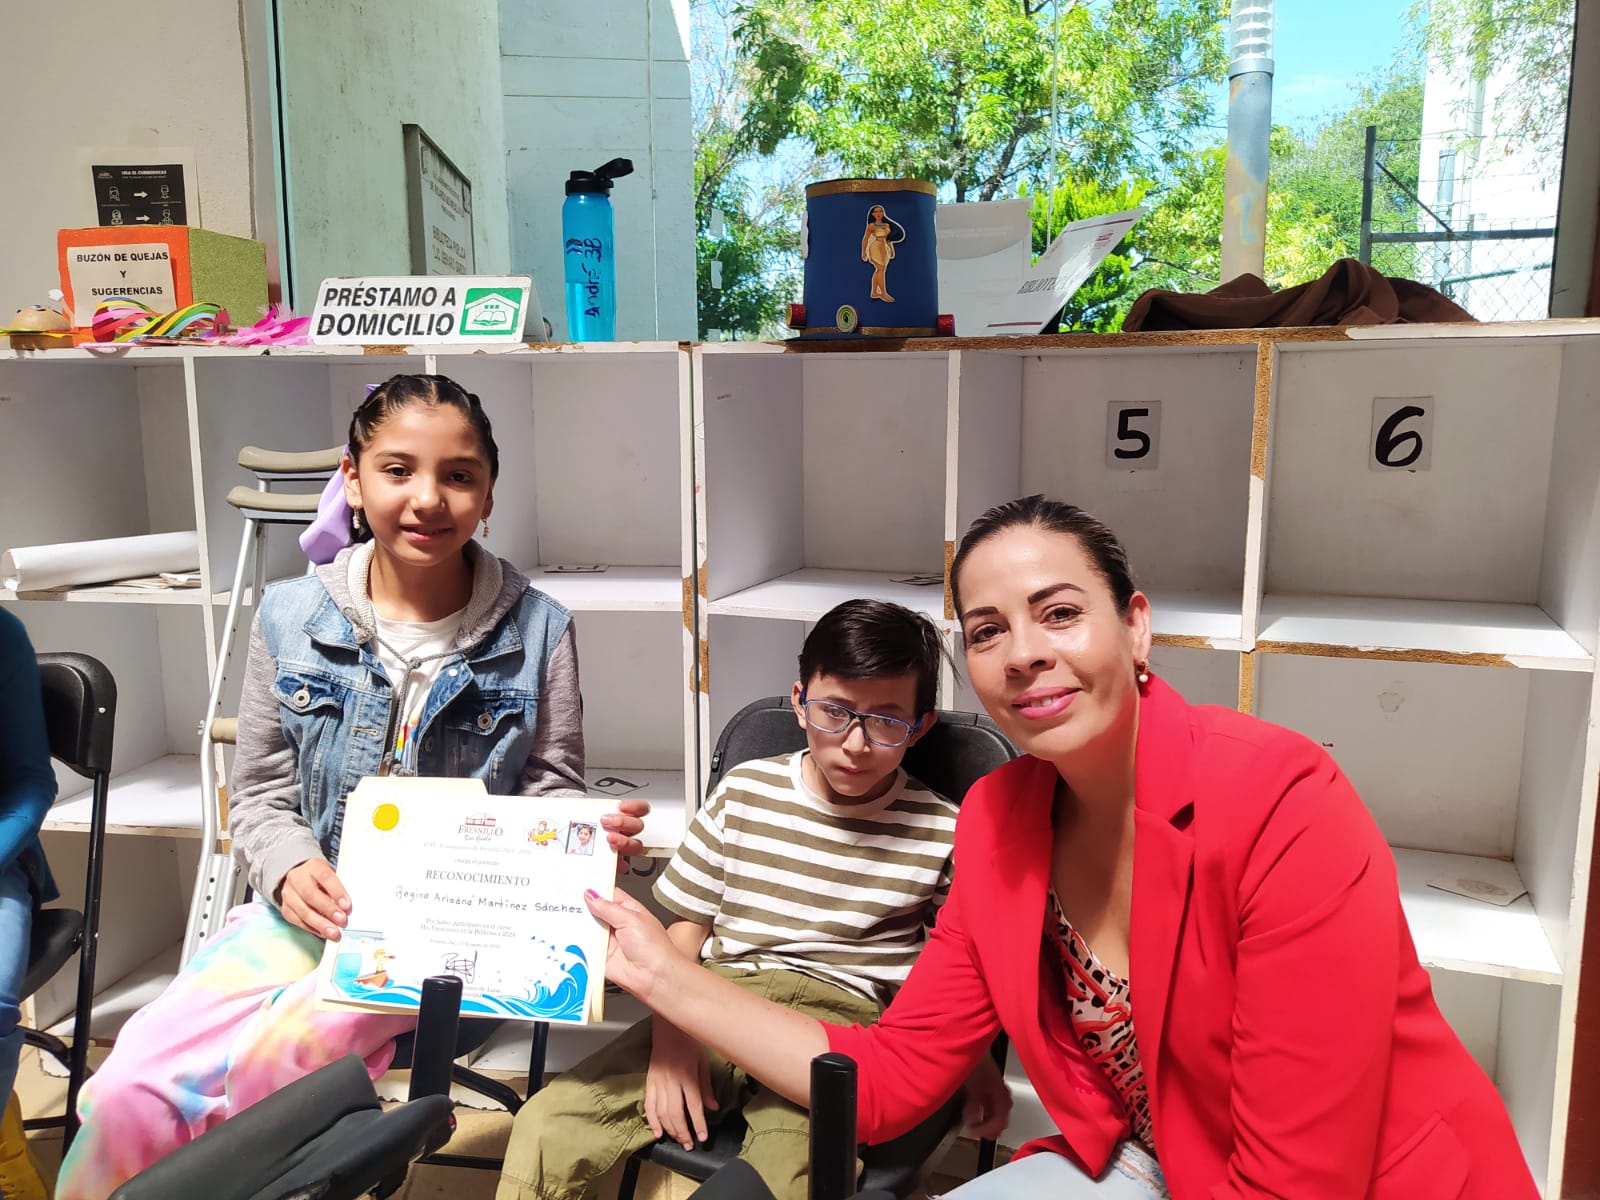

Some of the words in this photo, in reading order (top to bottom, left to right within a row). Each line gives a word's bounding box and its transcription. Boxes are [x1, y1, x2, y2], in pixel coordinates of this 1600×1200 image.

[114, 253, 128, 262] DE
[130, 251, 169, 262] QUEJAS
[120, 270, 127, 279] Y
[91, 286, 163, 296] SUGERENCIAS
[323, 281, 437, 307] PRÉSTAMO
[441, 286, 456, 307] A
[316, 313, 455, 337] DOMICILIO
[1114, 408, 1150, 459] 5
[1375, 405, 1425, 467] 6
[425, 869, 530, 887] RECONOCIMIENTO
